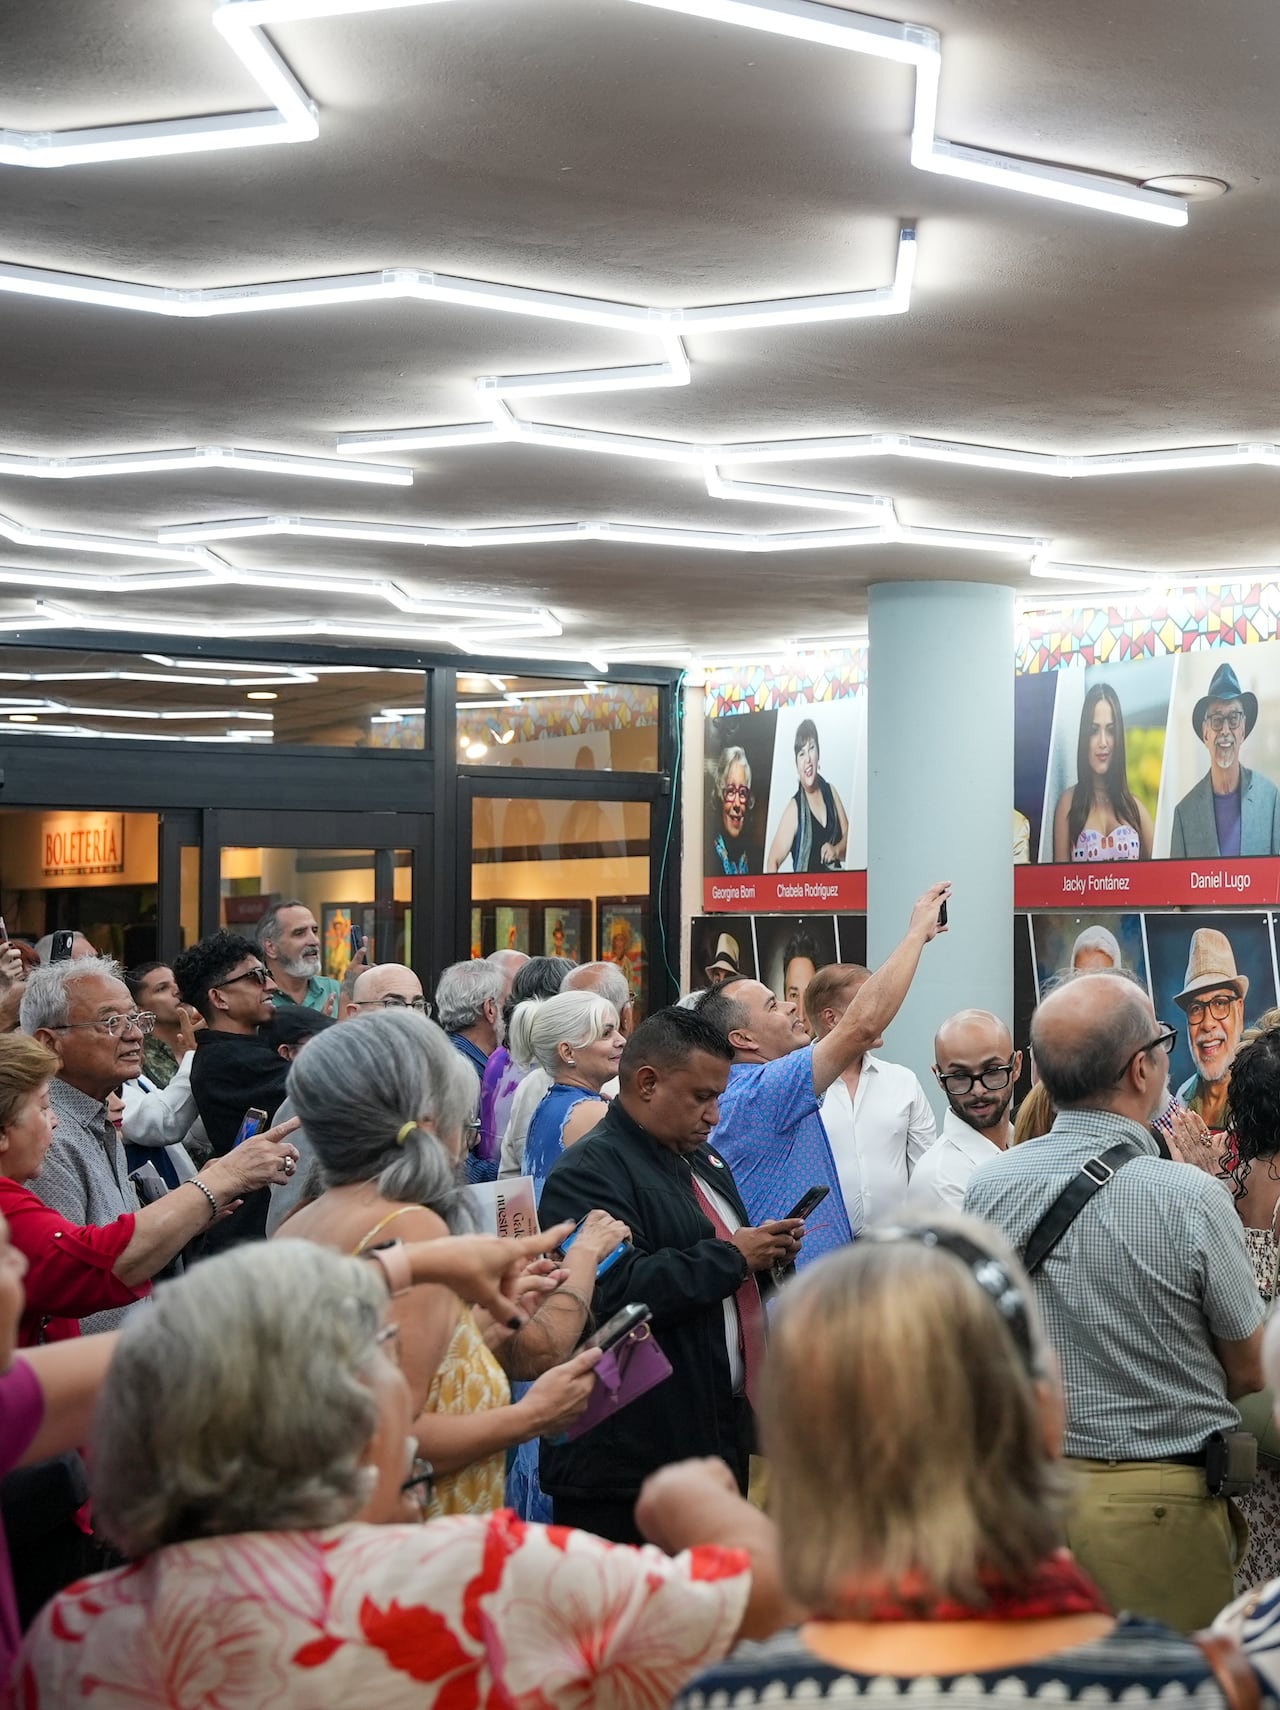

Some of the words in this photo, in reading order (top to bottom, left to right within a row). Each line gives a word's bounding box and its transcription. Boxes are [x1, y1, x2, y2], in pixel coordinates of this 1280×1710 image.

[46, 818, 117, 867] BOLETERÍA
[777, 884, 803, 898] Chabela
[804, 883, 839, 900] Rodríguez
[1062, 875, 1086, 895] Jacky
[1088, 873, 1130, 891] Fontánez
[1190, 871, 1222, 889] Daniel
[1225, 873, 1251, 892] Lugo
[712, 885, 739, 902] Georgina
[497, 1194, 508, 1237] nuestr
[513, 1212, 525, 1239] Gale
